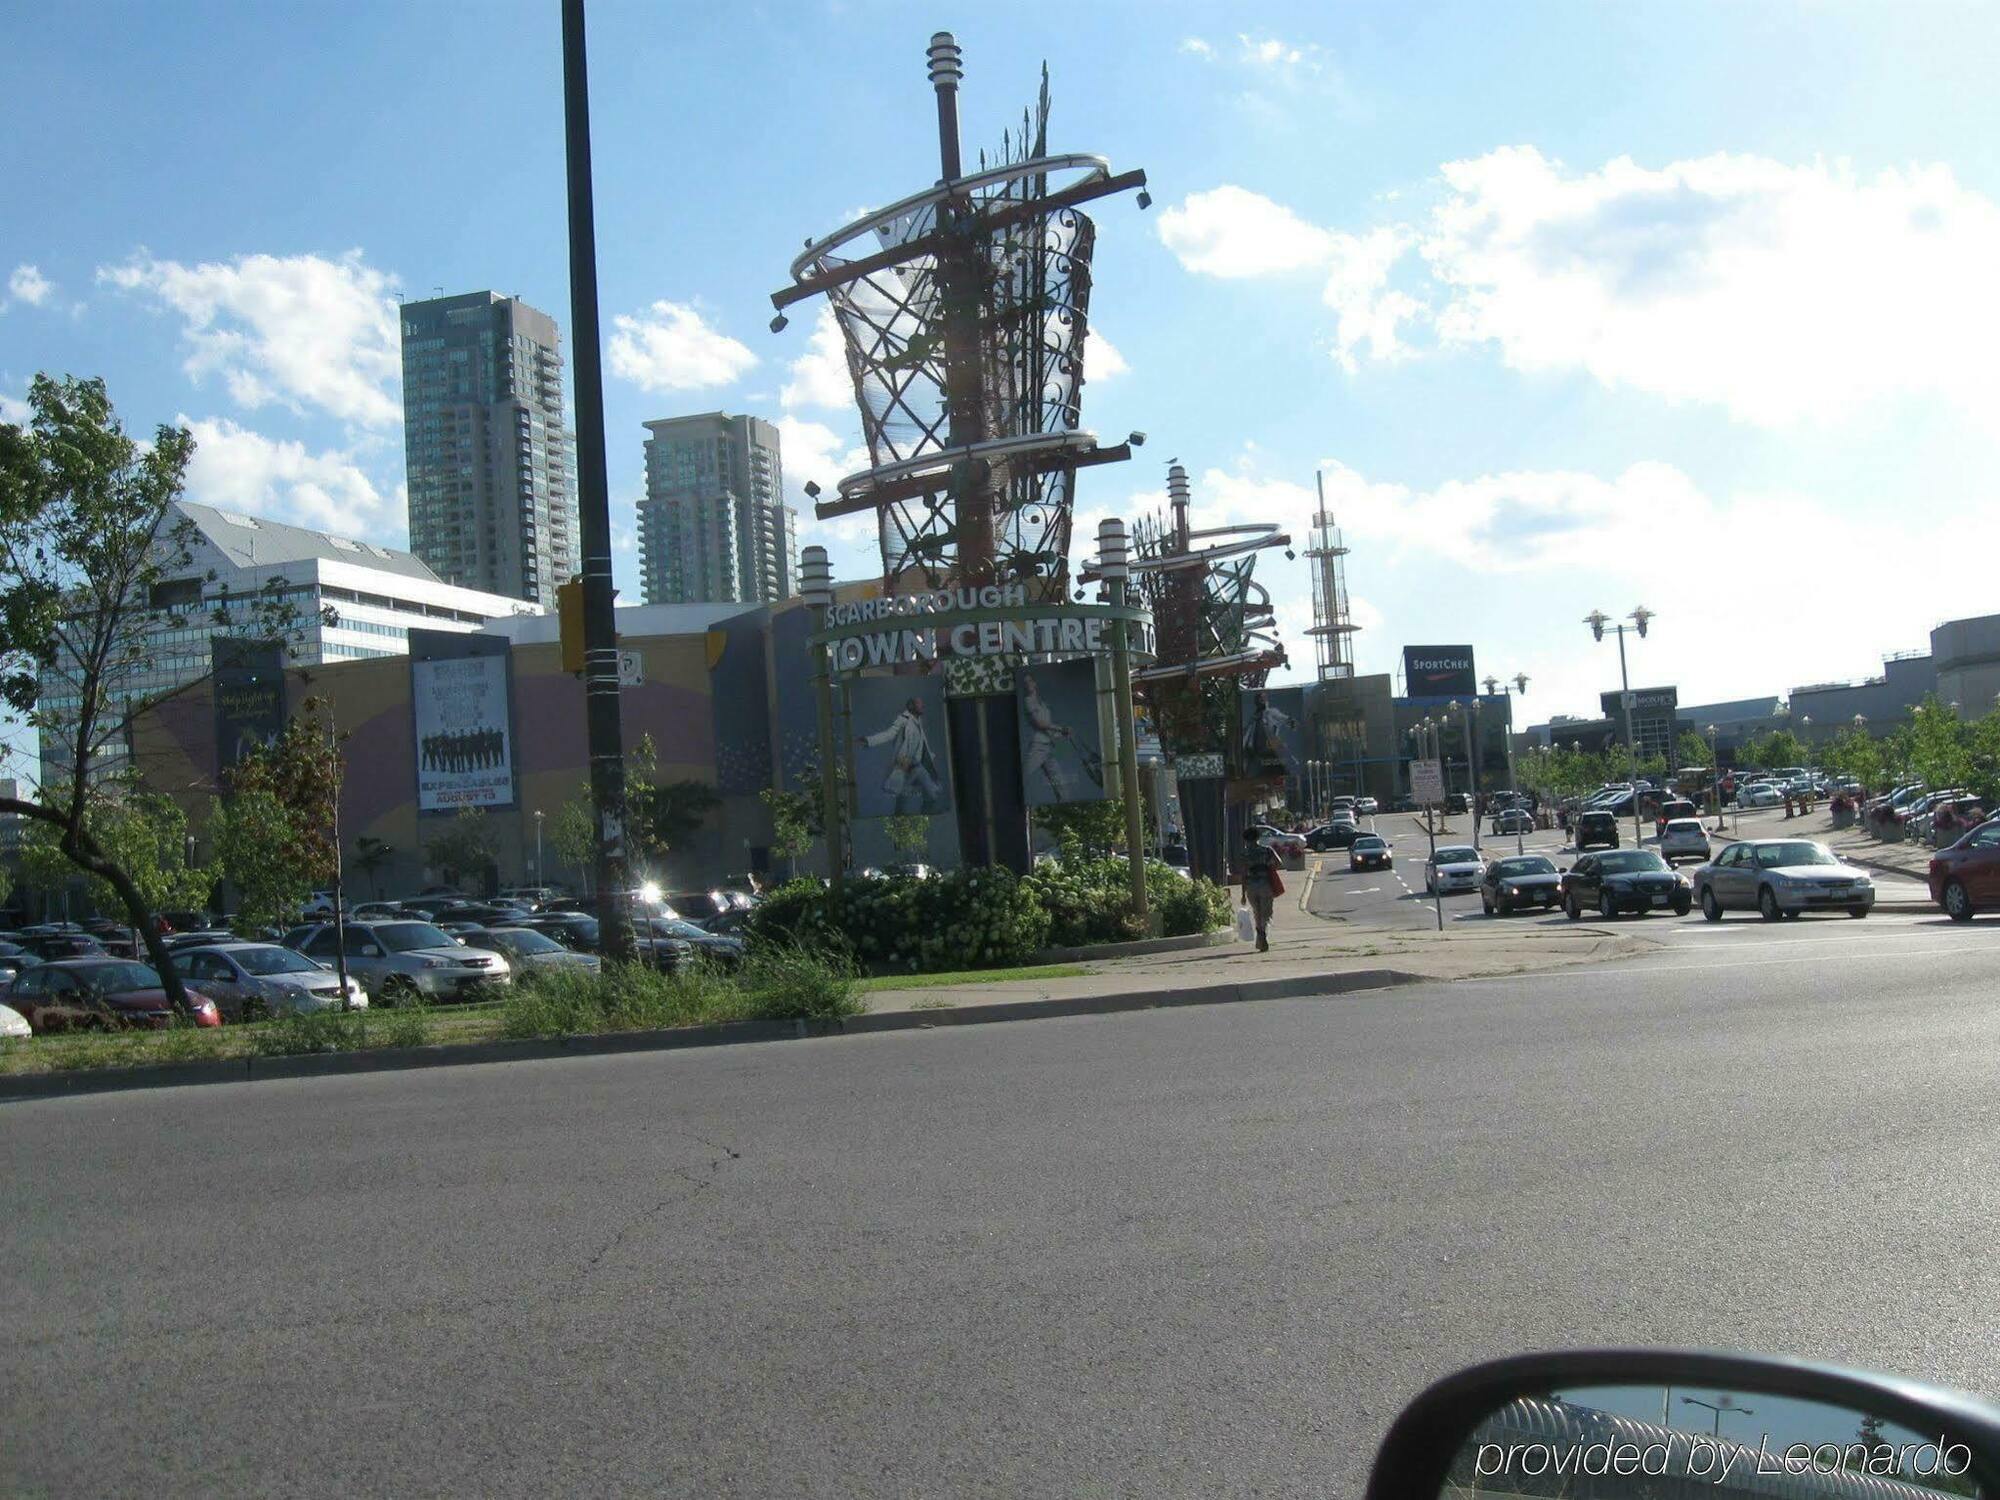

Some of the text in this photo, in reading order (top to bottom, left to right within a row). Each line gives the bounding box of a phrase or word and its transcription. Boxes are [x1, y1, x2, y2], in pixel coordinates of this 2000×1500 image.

[825, 585, 1025, 629] SCARBOROUGH
[827, 617, 1101, 672] TOWN CENTRE
